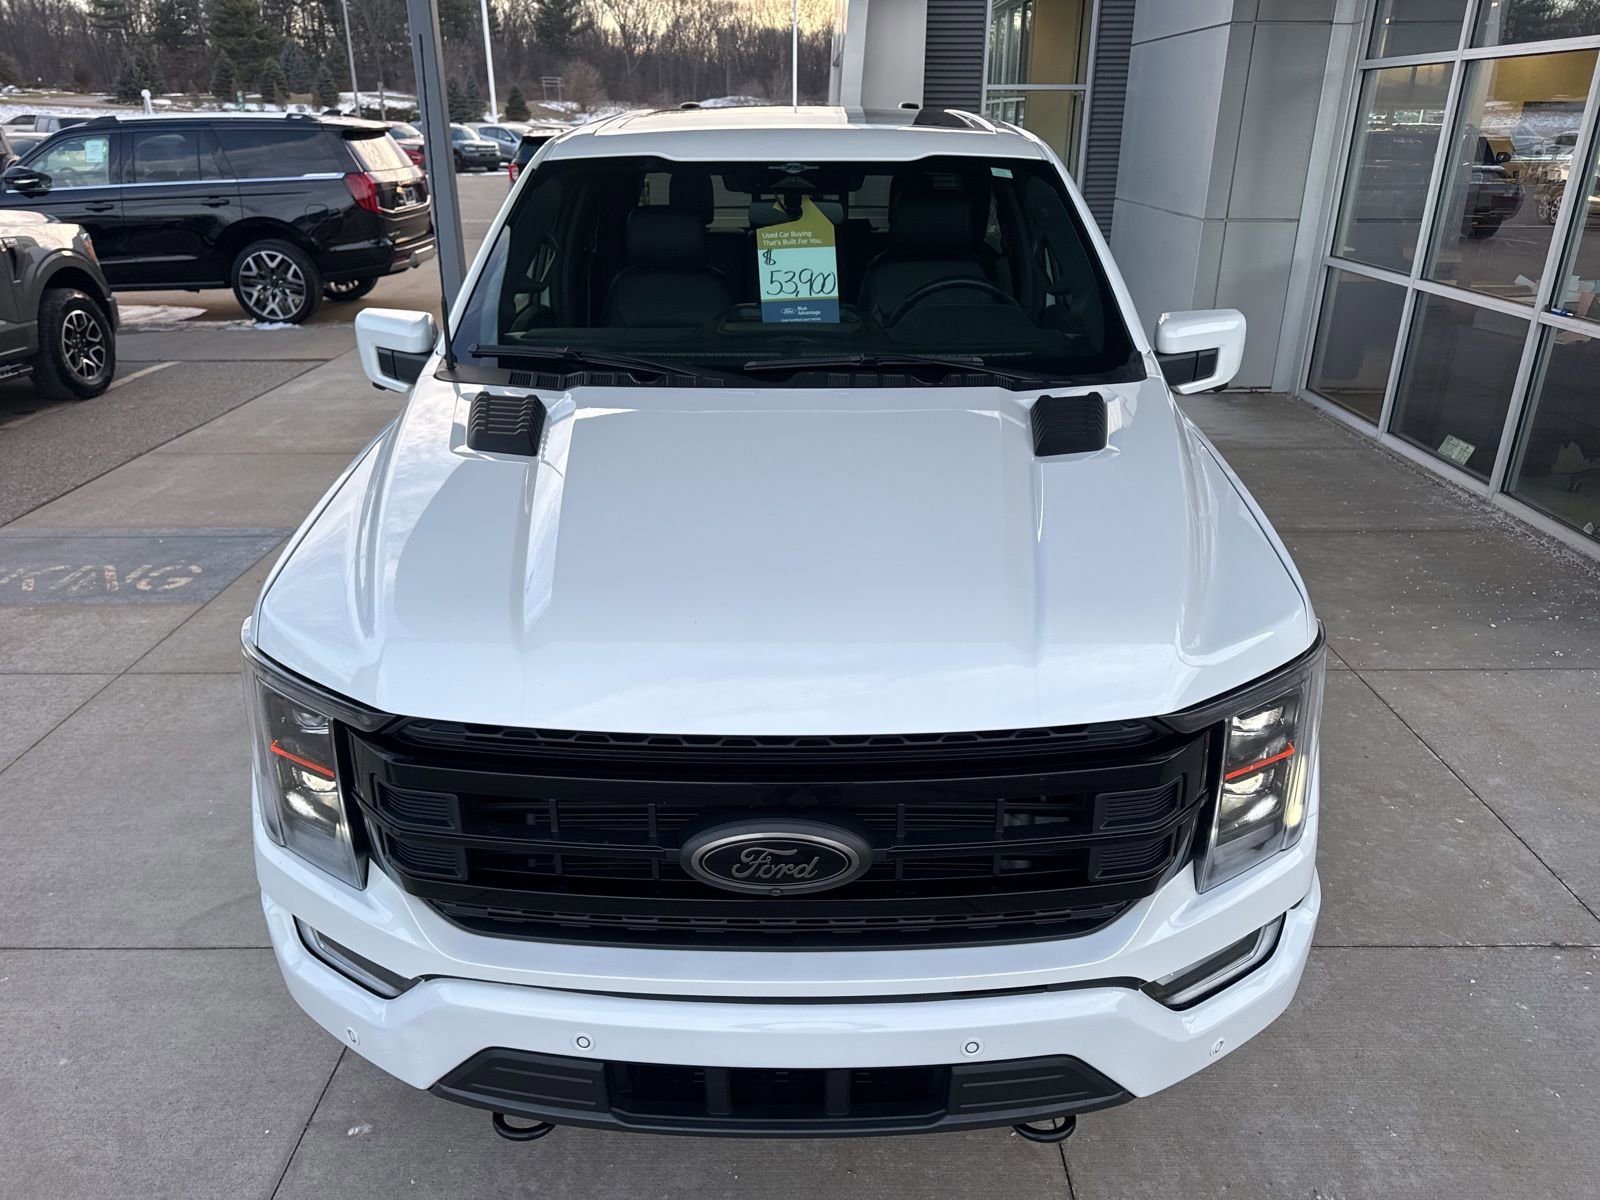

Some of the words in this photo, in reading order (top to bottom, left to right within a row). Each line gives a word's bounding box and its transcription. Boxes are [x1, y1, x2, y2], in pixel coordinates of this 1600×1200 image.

[762, 248, 776, 266] $
[766, 268, 836, 297] 53,900
[0, 563, 203, 592] KING
[731, 847, 820, 879] Ford
